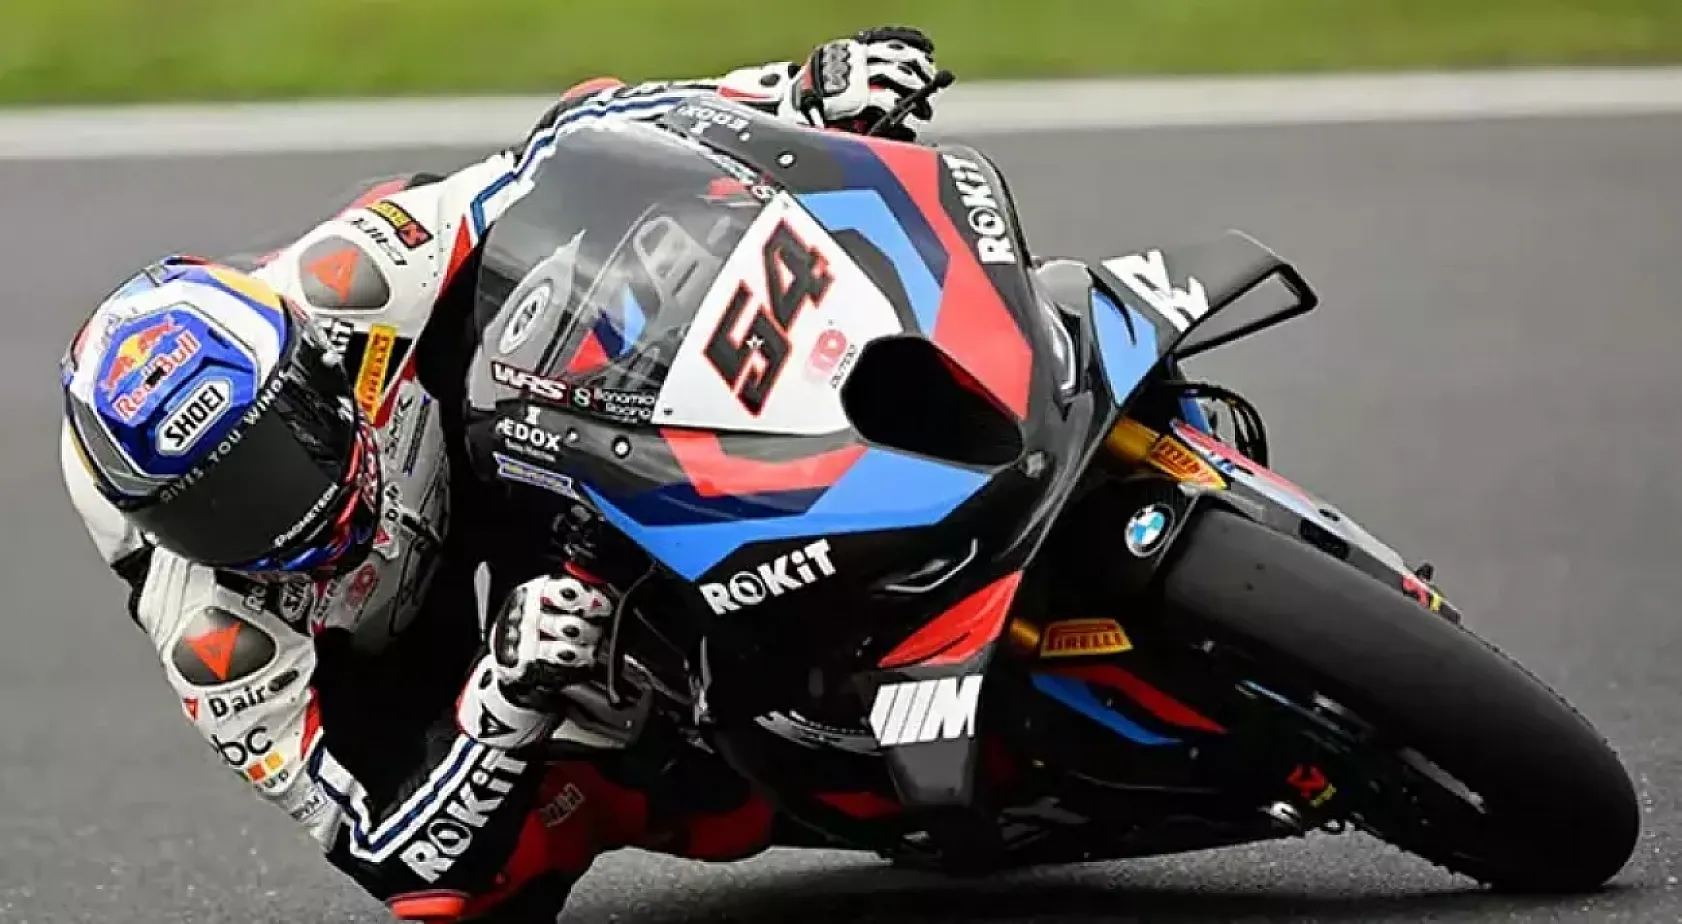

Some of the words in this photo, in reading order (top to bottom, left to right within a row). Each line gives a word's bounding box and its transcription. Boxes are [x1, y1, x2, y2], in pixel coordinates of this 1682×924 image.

[942, 153, 1016, 263] ROKiT
[702, 217, 834, 418] 54
[164, 385, 226, 447] SHOEI
[208, 428, 242, 463] YOU
[500, 418, 562, 452] EDOX
[699, 538, 836, 616] ROKiT
[1047, 622, 1125, 651] PIRELLI
[399, 748, 528, 884] ROKiT
